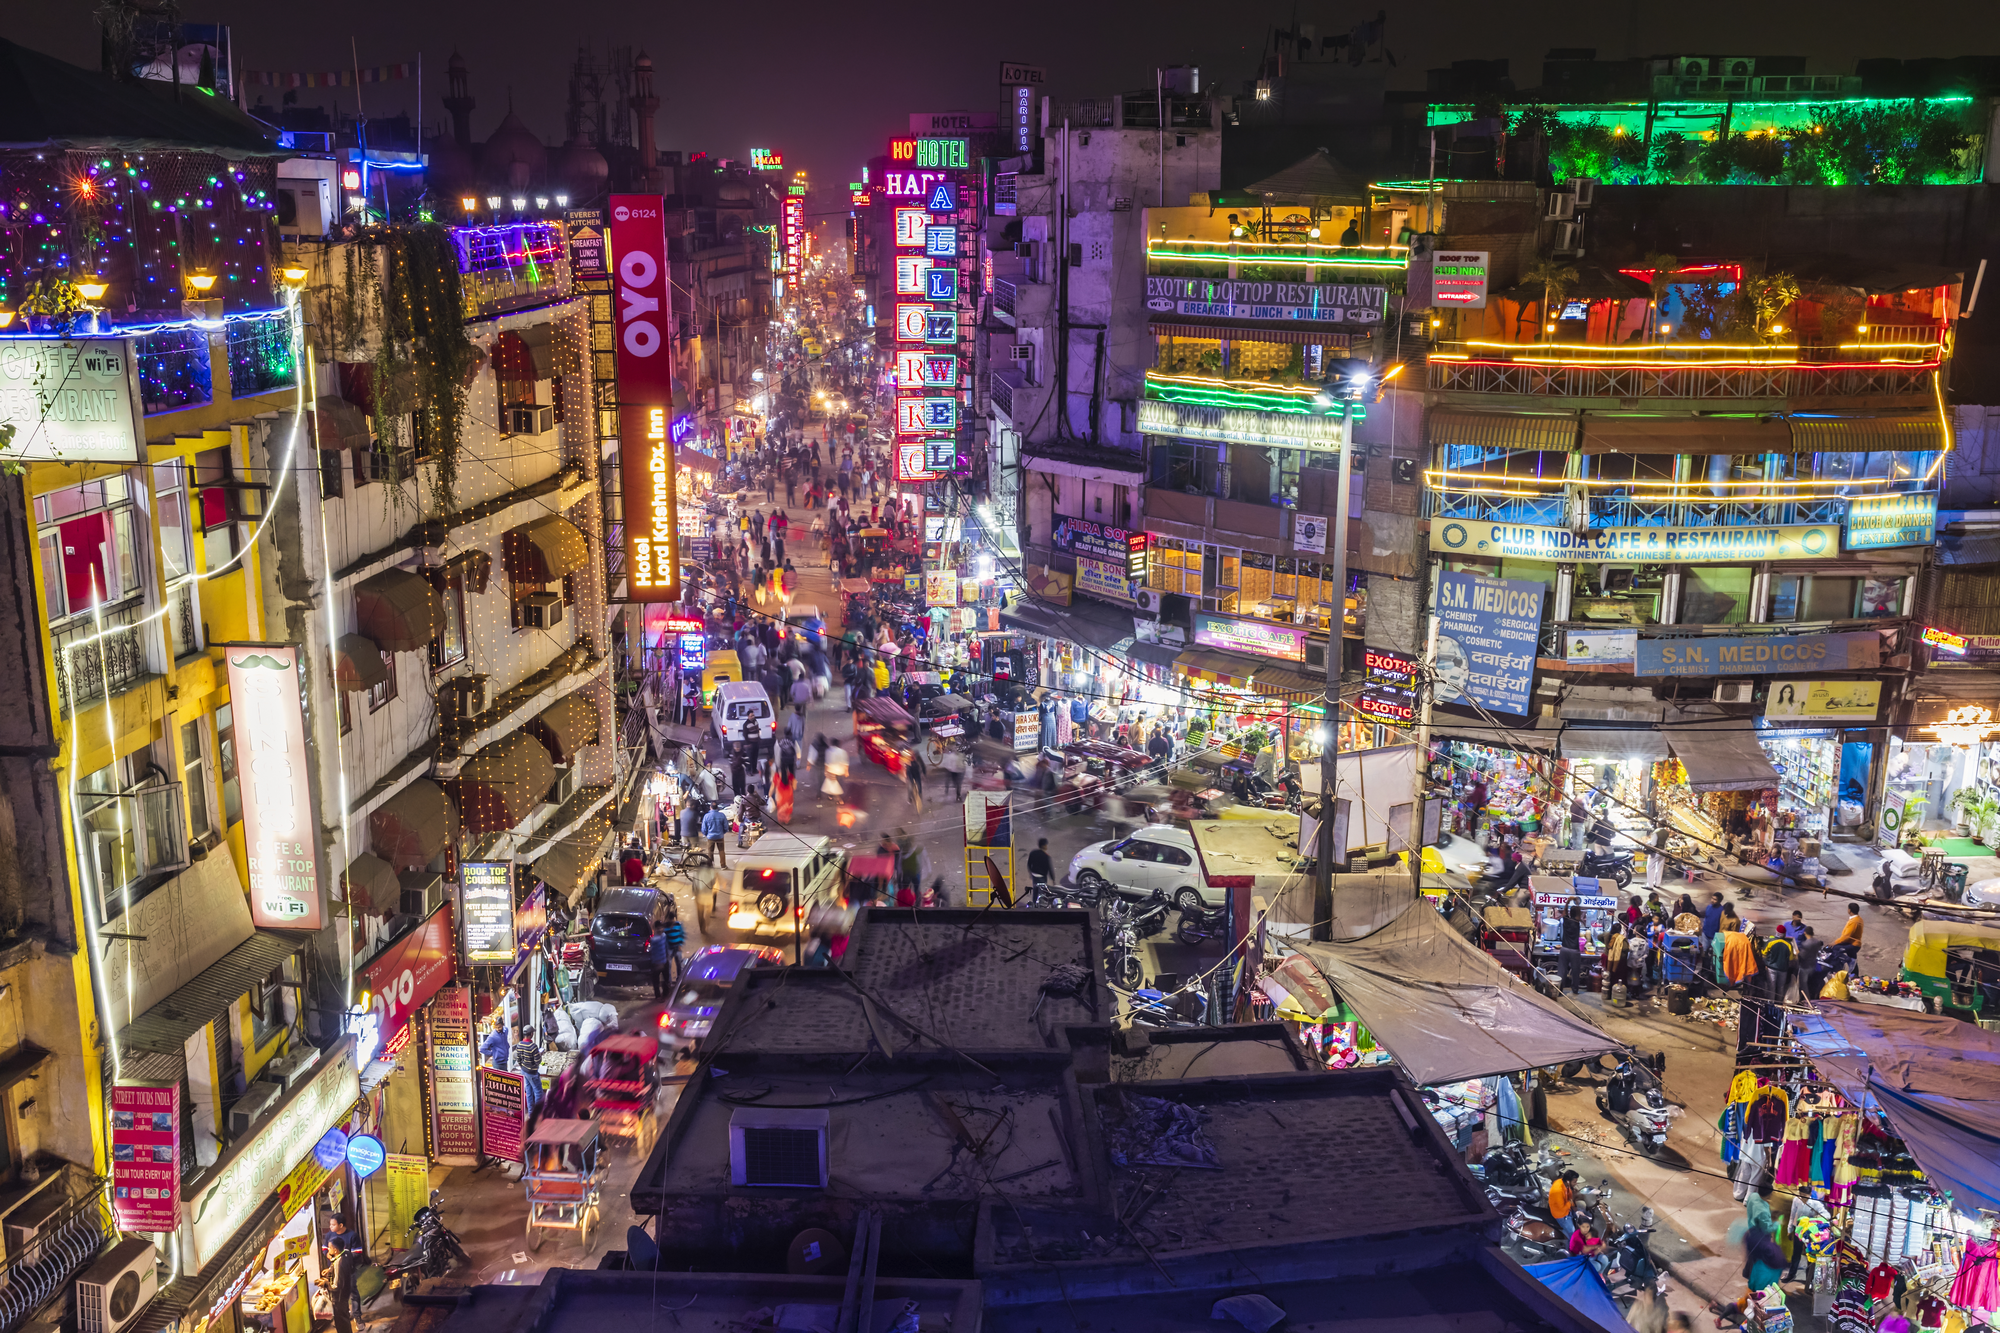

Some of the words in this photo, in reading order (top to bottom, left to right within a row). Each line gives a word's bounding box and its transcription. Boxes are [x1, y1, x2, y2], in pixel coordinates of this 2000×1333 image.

[1005, 67, 1044, 83] HOTEL
[1019, 88, 1029, 124] HARI
[931, 116, 975, 129] HOTEL
[754, 156, 782, 165] AMAN
[916, 139, 969, 168] HOTEL
[788, 186, 806, 196] HOTEL
[885, 173, 947, 195] HA
[852, 195, 871, 203] HOTEL
[569, 210, 601, 219] EVEREST
[570, 218, 602, 226] KITCHEN
[632, 209, 656, 219] 6124
[572, 239, 603, 248] BREAKFAST
[579, 248, 598, 258] LUNCH
[579, 258, 600, 268] DINNER
[1434, 266, 1458, 276] CLUB
[1460, 266, 1485, 276] INDIA
[1147, 277, 1197, 299] EXOTIC
[1200, 280, 1274, 304] ROOFTOP
[1275, 283, 1386, 307] RESTAURANT
[620, 250, 661, 358] OYO
[1183, 302, 1238, 317] BREAKFAST
[1250, 306, 1283, 319] LUNCH
[1296, 308, 1336, 321] DINNER
[94, 348, 108, 356] Free
[1, 346, 82, 380] CAFE
[648, 408, 664, 439] Inn
[1138, 400, 1176, 425] EXOTIC
[1177, 404, 1228, 430] ROOFTOP
[1229, 409, 1258, 433] CAFE
[1259, 412, 1269, 434] &
[1850, 514, 1882, 531] LUNCH
[1884, 514, 1894, 528] &
[1894, 512, 1933, 528] DINNER
[1068, 518, 1102, 537] HIRA
[1104, 526, 1134, 542] SON
[1490, 526, 1535, 546] CLUB
[1541, 530, 1590, 549] INDIA
[1594, 531, 1641, 549] CAFE
[1647, 532, 1659, 549] &
[1665, 529, 1780, 550] RESTAURANT
[1860, 530, 1922, 546] ENTRANCE
[1502, 545, 1537, 557] INDIAN
[1546, 549, 1618, 560] CONTINENTAL
[1626, 550, 1672, 560] CHINESE
[1674, 550, 1685, 560] &
[1689, 550, 1736, 560] JAPANESE
[1738, 549, 1765, 558] FOOD
[634, 537, 652, 587] Hotel
[654, 545, 672, 587] Lord
[1078, 558, 1100, 572] HIRA
[1102, 564, 1127, 578] SONS
[1082, 576, 1093, 584] READY
[1093, 578, 1104, 586] MADE
[1104, 580, 1125, 592] GARMENTS
[1082, 582, 1102, 592] COMPLETE
[1102, 587, 1118, 596] FAMILY
[1118, 590, 1130, 598] SHOP
[1442, 582, 1468, 609] S.N.
[1472, 585, 1539, 619] MEDICOS
[1445, 610, 1478, 622] CHEMIST
[1444, 620, 1484, 635] PHARMACY
[1502, 618, 1538, 632] SERGICAL
[1207, 621, 1256, 639] EXOTIC
[1258, 630, 1296, 646] CAFÉ
[1500, 628, 1537, 643] MEDICINE
[1466, 636, 1503, 650] COSMETIC
[1471, 650, 1533, 672] दवाईयाँ
[1662, 646, 1710, 664] S.N.
[1719, 642, 1826, 663] MEDICOS
[1670, 666, 1710, 674] CHEMIST
[1719, 664, 1768, 673] PHARMACY
[1776, 662, 1819, 672] COSMETIC
[1468, 672, 1530, 692] दवाईयाँ
[1362, 700, 1412, 719] EXOTIC
[1016, 714, 1028, 724] HIRA
[1028, 713, 1038, 722] SONS
[255, 841, 291, 855] CFE
[294, 842, 304, 856] &
[249, 856, 284, 872] ROF
[287, 860, 314, 873] TOP
[464, 866, 488, 876] ROOF
[489, 867, 507, 876] TOP
[250, 872, 315, 892] REAURANT
[465, 876, 507, 885] COUISINE
[1538, 893, 1551, 904] श्री
[370, 966, 382, 980] 6124
[372, 968, 414, 1029] OYO
[485, 1080, 521, 1095] ДИПАК
[114, 1090, 135, 1105] STREET
[136, 1091, 154, 1105] TOURS
[154, 1092, 171, 1106] INDIA
[221, 1110, 293, 1194] SINGH'S
[296, 1062, 336, 1117] CAFE
[226, 1195, 236, 1216] &
[236, 1165, 267, 1202] ROOF
[268, 1138, 290, 1170] TOP
[290, 1066, 352, 1146] RESTAURANT
[350, 1146, 380, 1158] magicpin
[115, 1168, 130, 1179] SLUM
[130, 1169, 145, 1180] TOUR
[145, 1170, 162, 1180] EVERY
[162, 1170, 172, 1180] DAY
